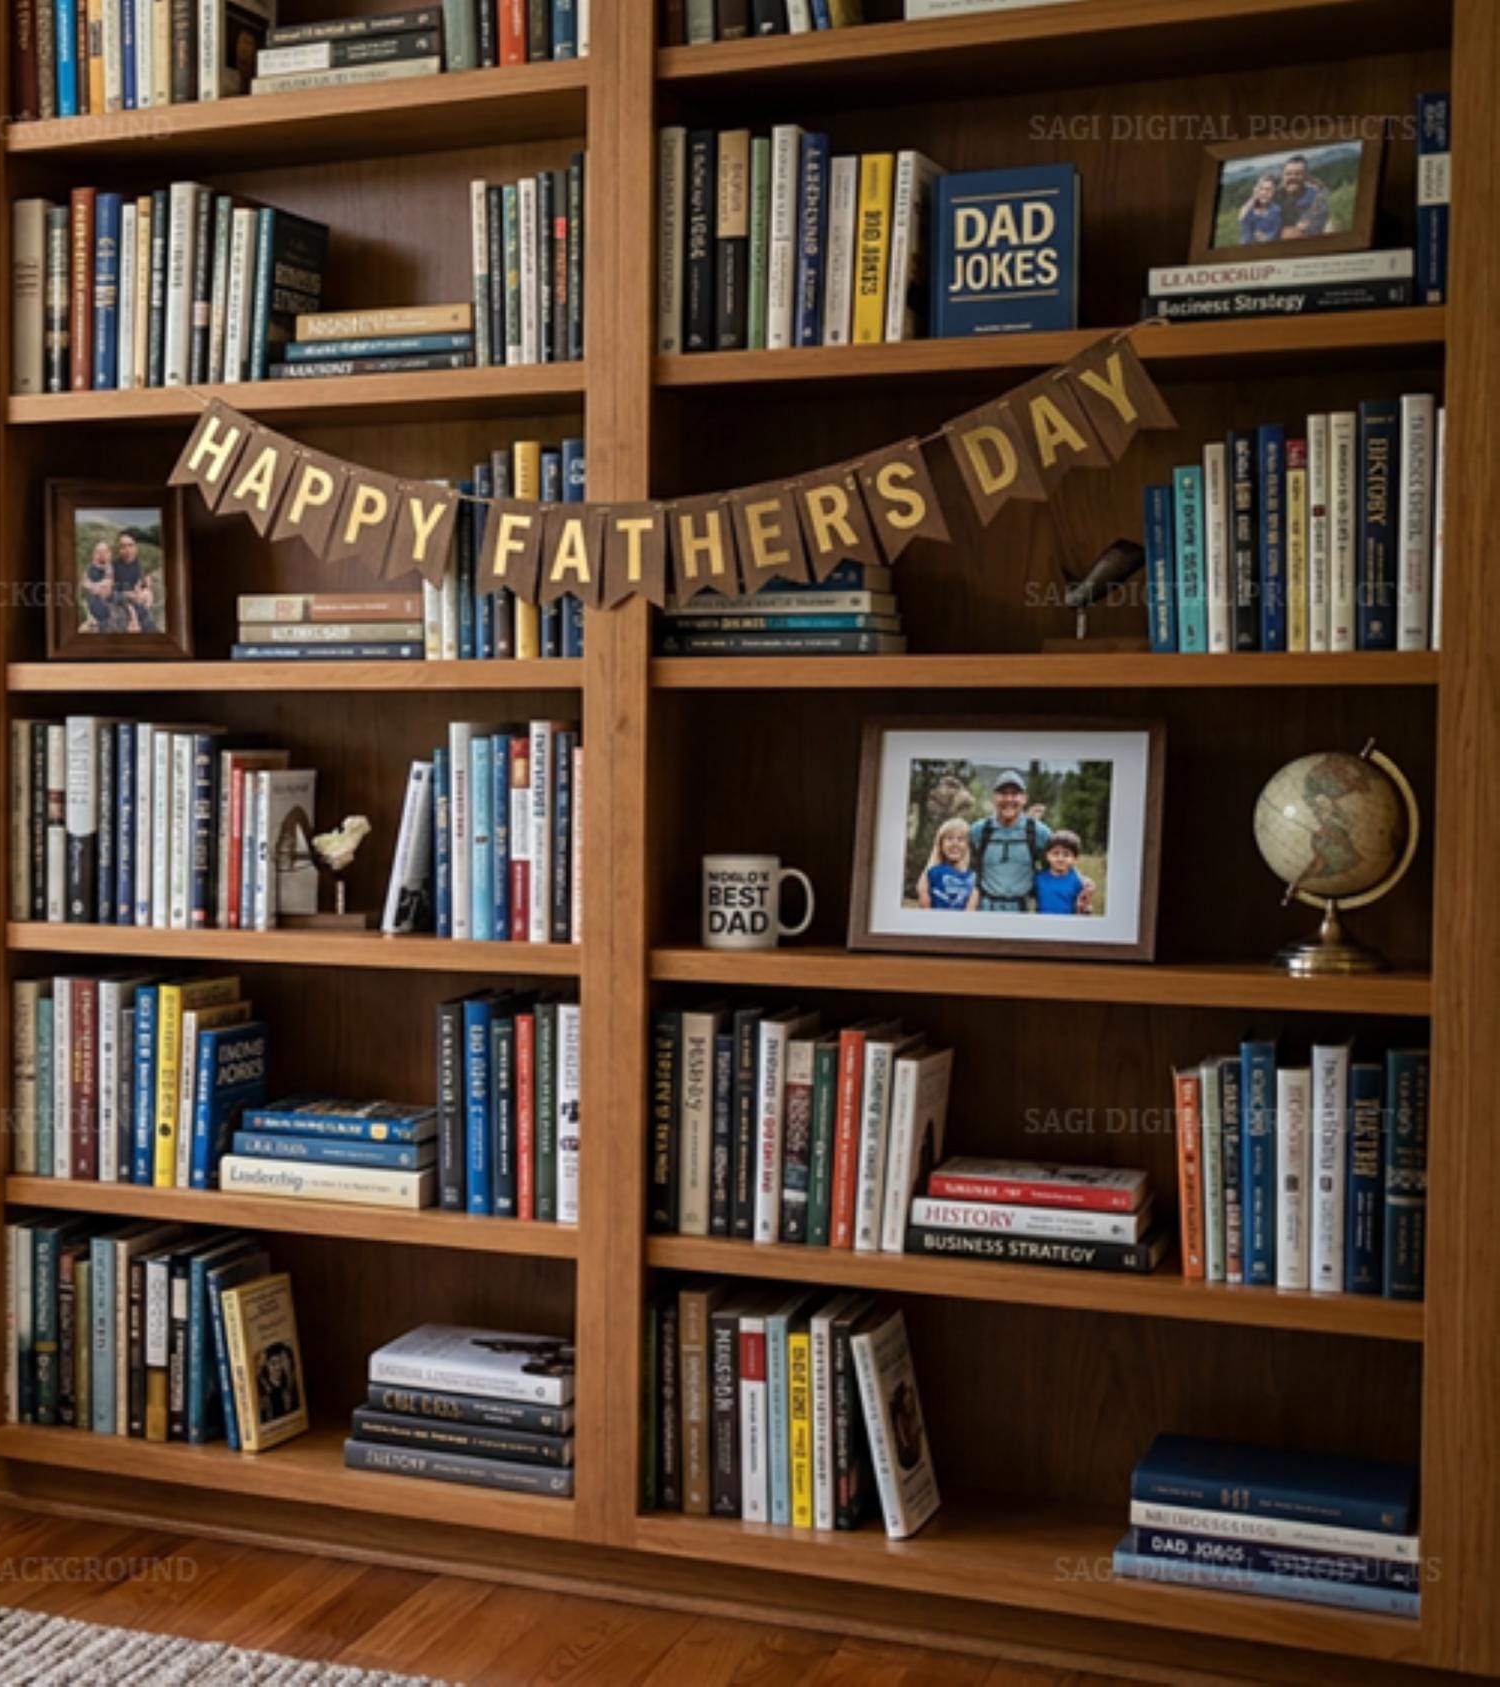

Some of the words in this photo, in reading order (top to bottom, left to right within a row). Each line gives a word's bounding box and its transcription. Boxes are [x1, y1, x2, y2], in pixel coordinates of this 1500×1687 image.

[955, 202, 1056, 251] DAD
[949, 248, 1059, 293] JOKES
[187, 415, 447, 561] HAPPY
[962, 353, 1137, 495] DAY
[708, 886, 770, 908] BEST
[708, 910, 770, 935] DAD
[925, 1205, 1015, 1228] HISTORY
[924, 1233, 1004, 1256] BUSINESS
[1008, 1240, 1097, 1263] STRATEGY
